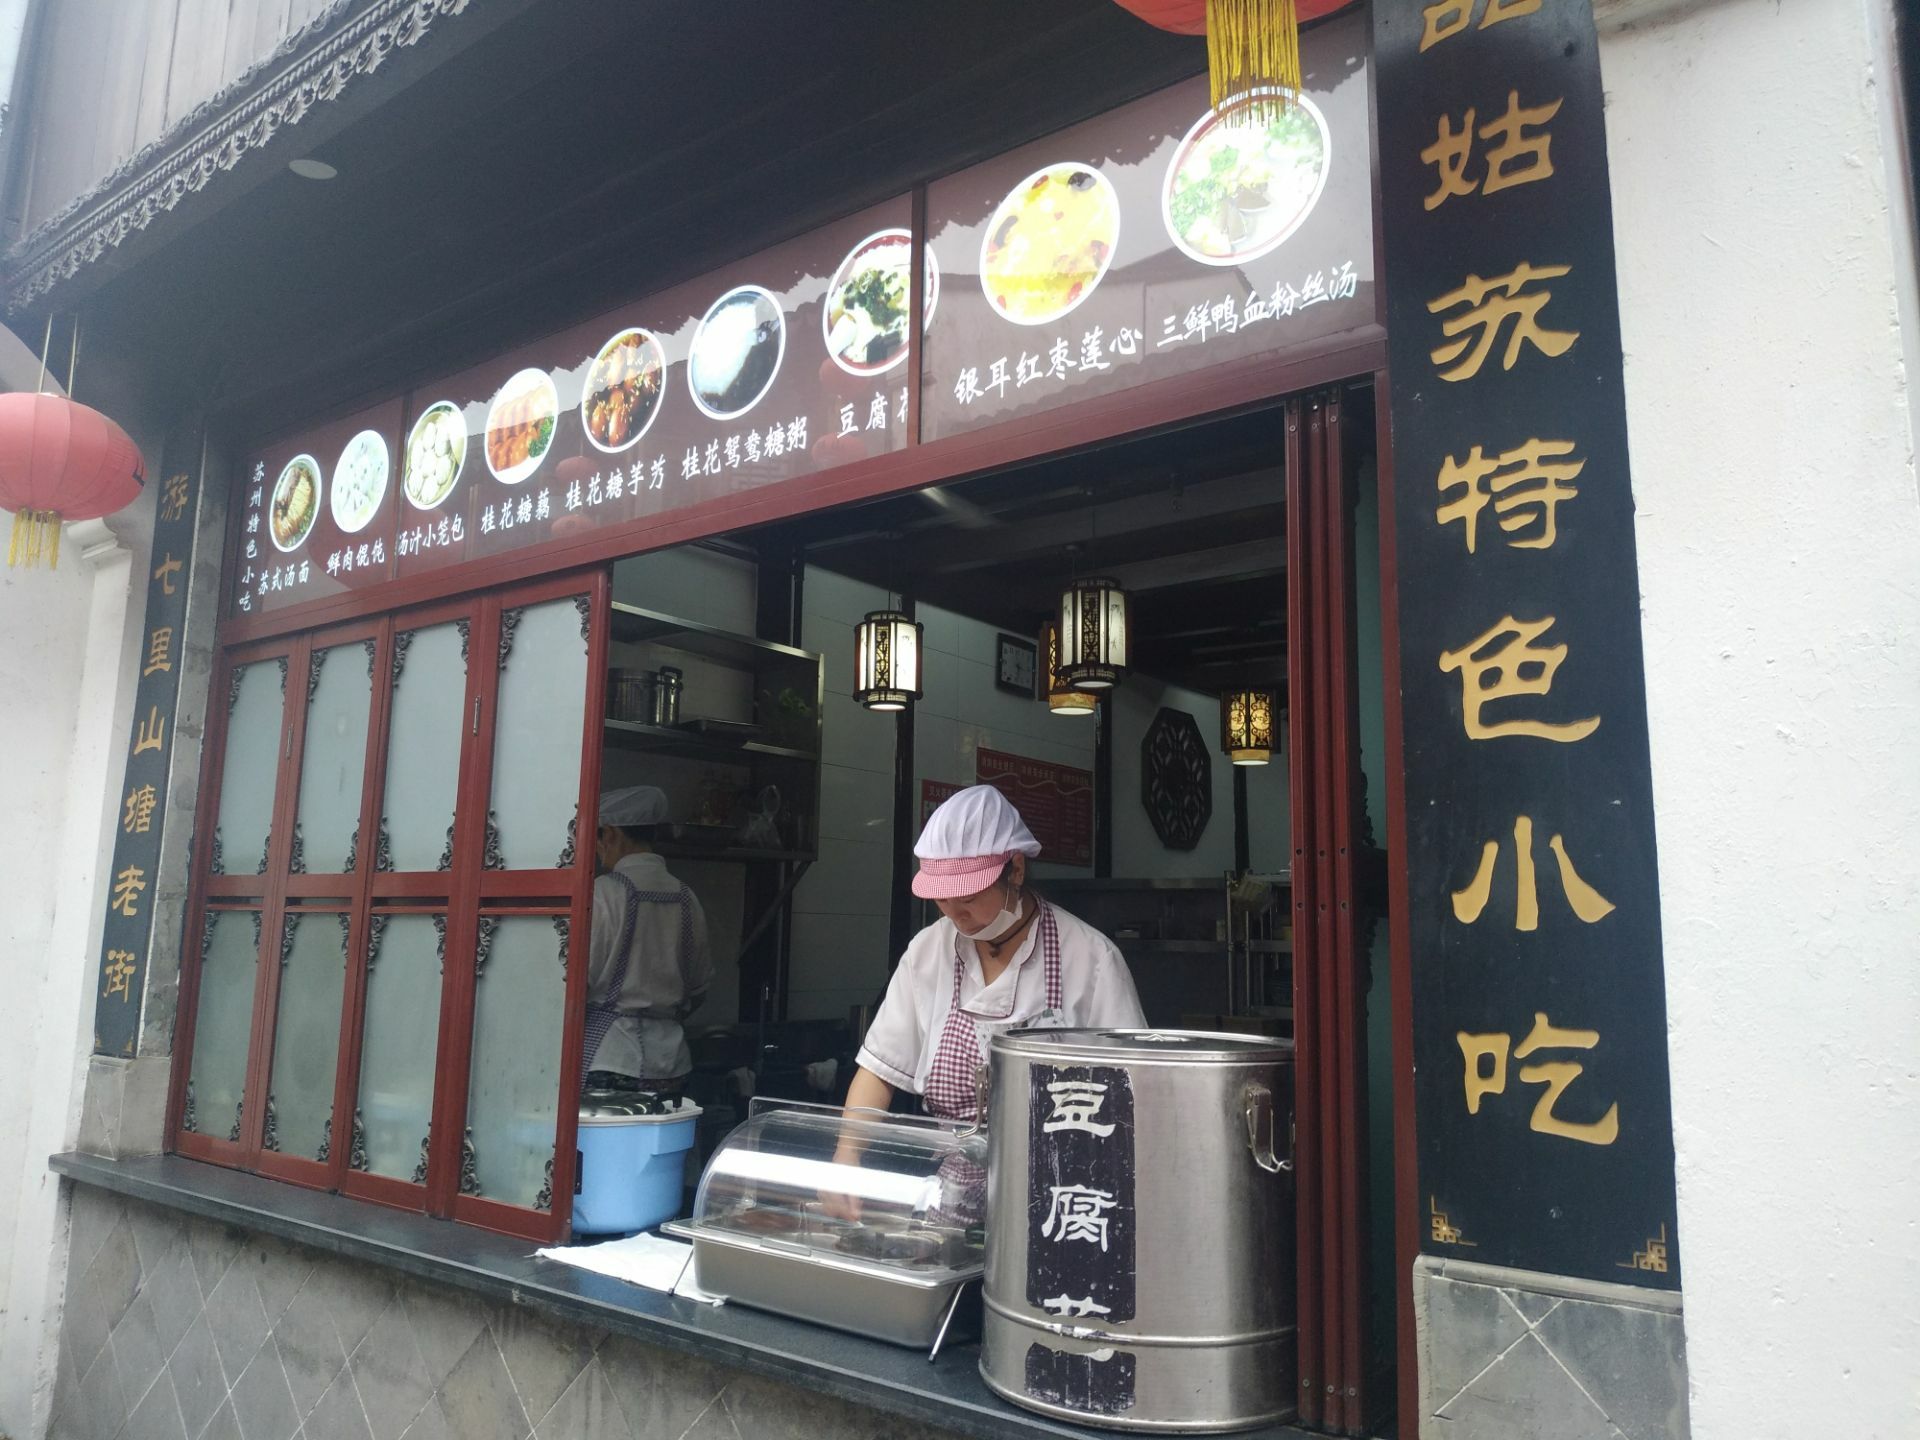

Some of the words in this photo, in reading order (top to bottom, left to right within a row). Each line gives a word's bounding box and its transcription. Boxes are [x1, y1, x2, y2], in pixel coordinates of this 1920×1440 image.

[1156, 260, 1358, 347] 三鲜鸭血粉丝汤
[953, 325, 1143, 404] 银耳红枣莲心
[680, 415, 807, 481] 桂花鸳鸯糖粥
[238, 460, 265, 612] 苏州特色小吃
[397, 513, 464, 557] 汤汁小笼包
[480, 487, 550, 535] 桂花糖藕
[257, 559, 311, 596] 苏式汤面
[326, 537, 386, 577] 鲜肉馄饨
[103, 473, 190, 1003] 游七里山塘老街
